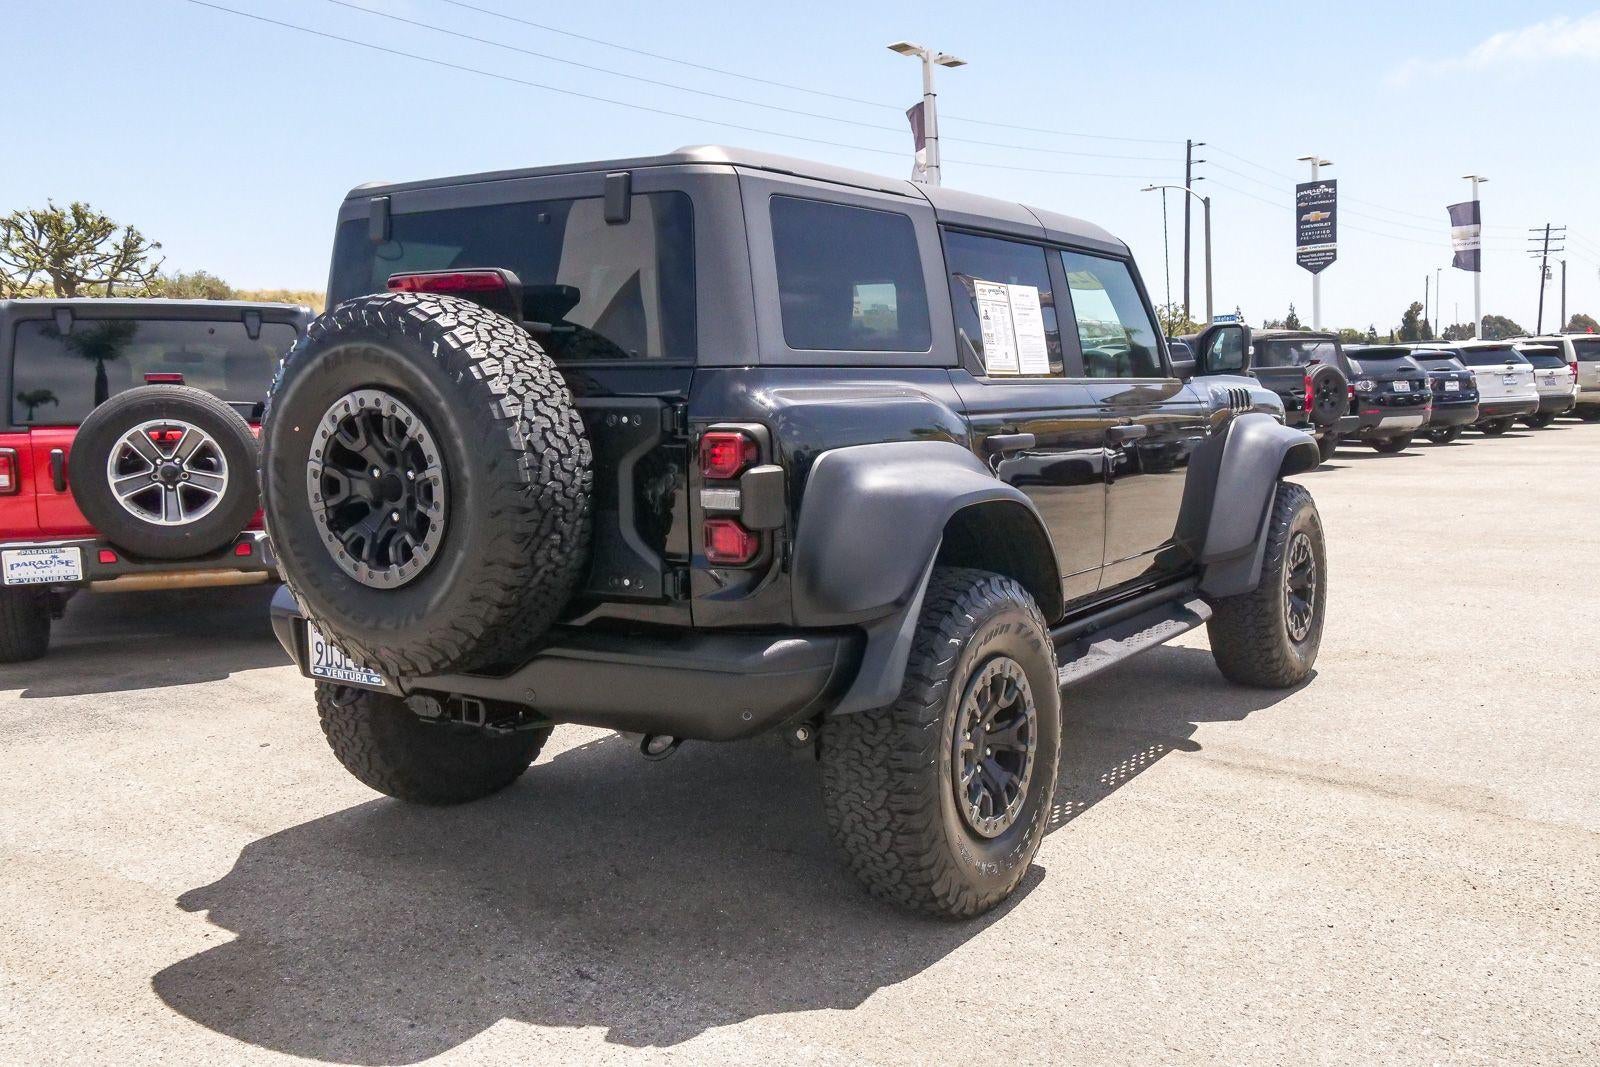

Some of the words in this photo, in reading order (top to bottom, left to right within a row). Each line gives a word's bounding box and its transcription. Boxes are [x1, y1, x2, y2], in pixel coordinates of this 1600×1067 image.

[1297, 186, 1335, 197] PARADISE
[10, 556, 75, 570] PARADISE
[326, 669, 368, 682] VENTURA
